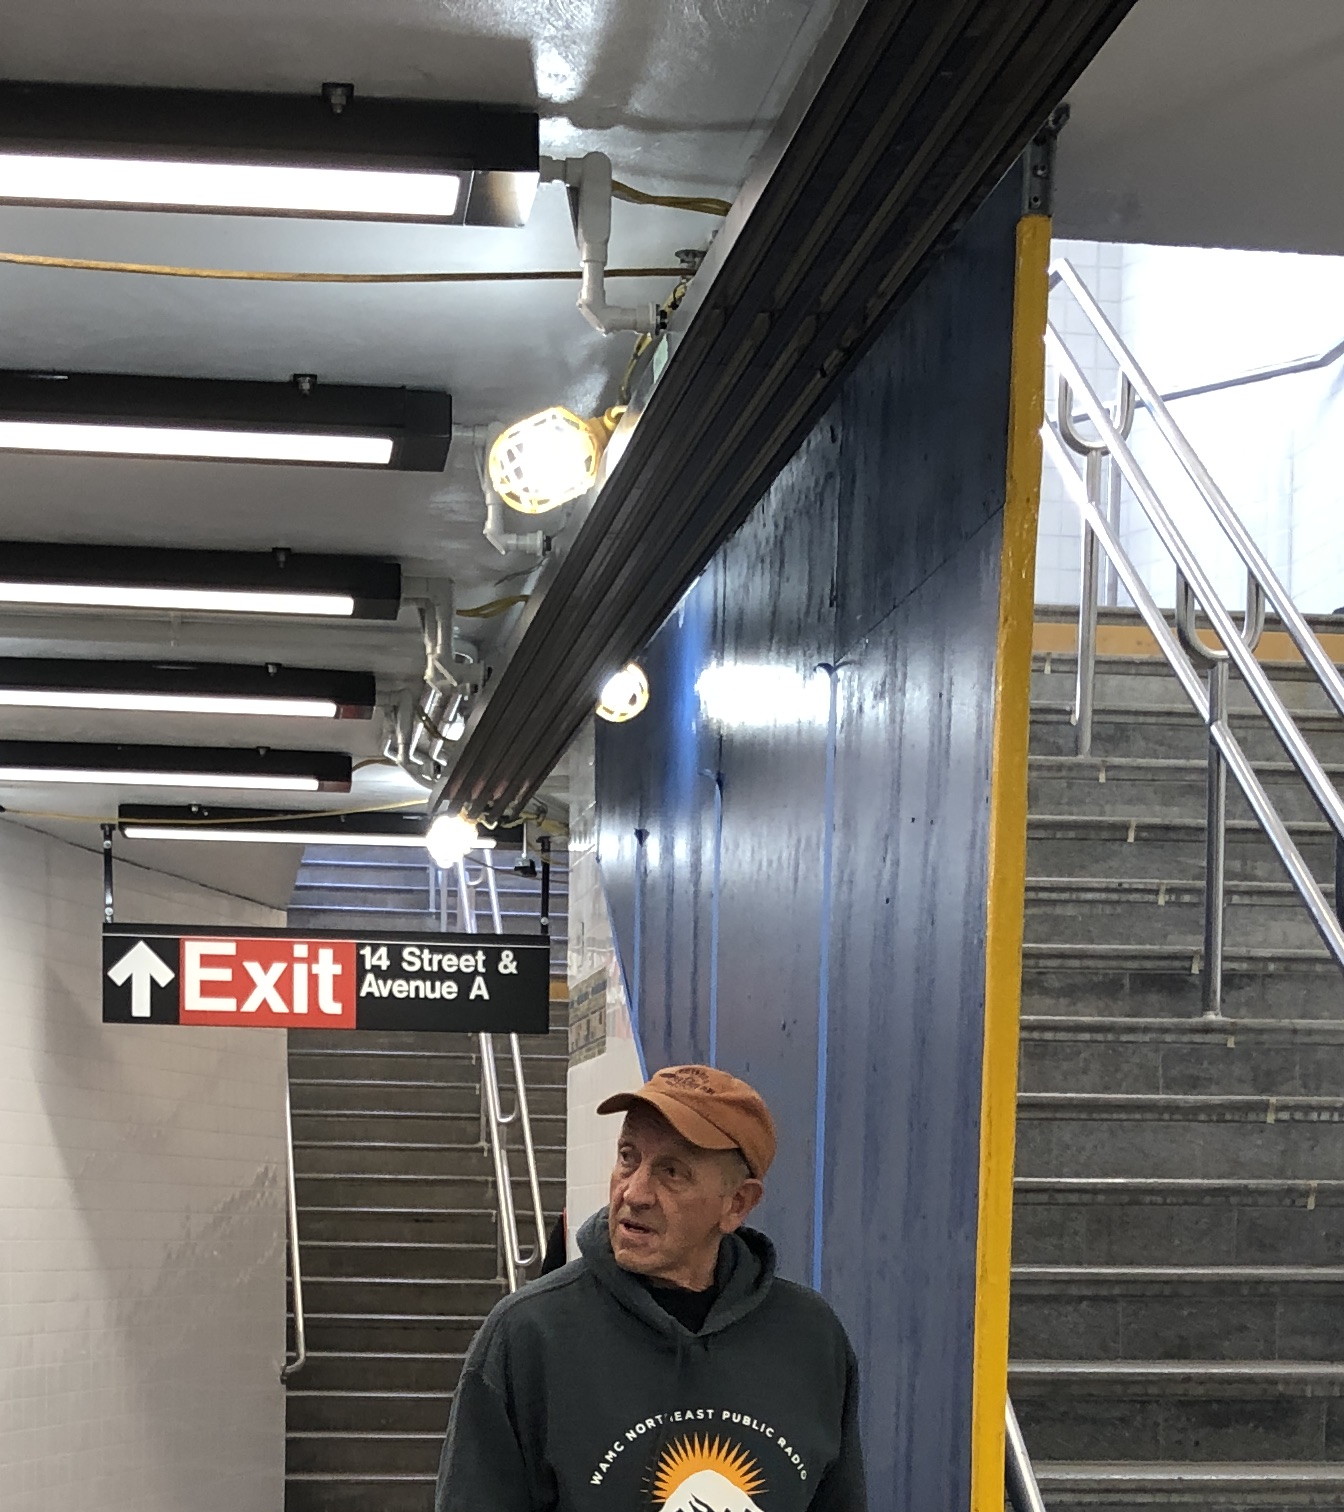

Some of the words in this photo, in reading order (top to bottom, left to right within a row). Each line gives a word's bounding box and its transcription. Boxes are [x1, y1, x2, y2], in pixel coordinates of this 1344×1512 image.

[184, 941, 343, 1014] Exit
[359, 946, 391, 971] 14
[401, 947, 486, 973] Street
[498, 949, 519, 975] &
[359, 973, 459, 1000] Avenue
[469, 975, 488, 1000] A
[590, 1441, 625, 1486] WAMC
[721, 1410, 775, 1438] PUBLIC
[776, 1436, 808, 1481] RADIO
